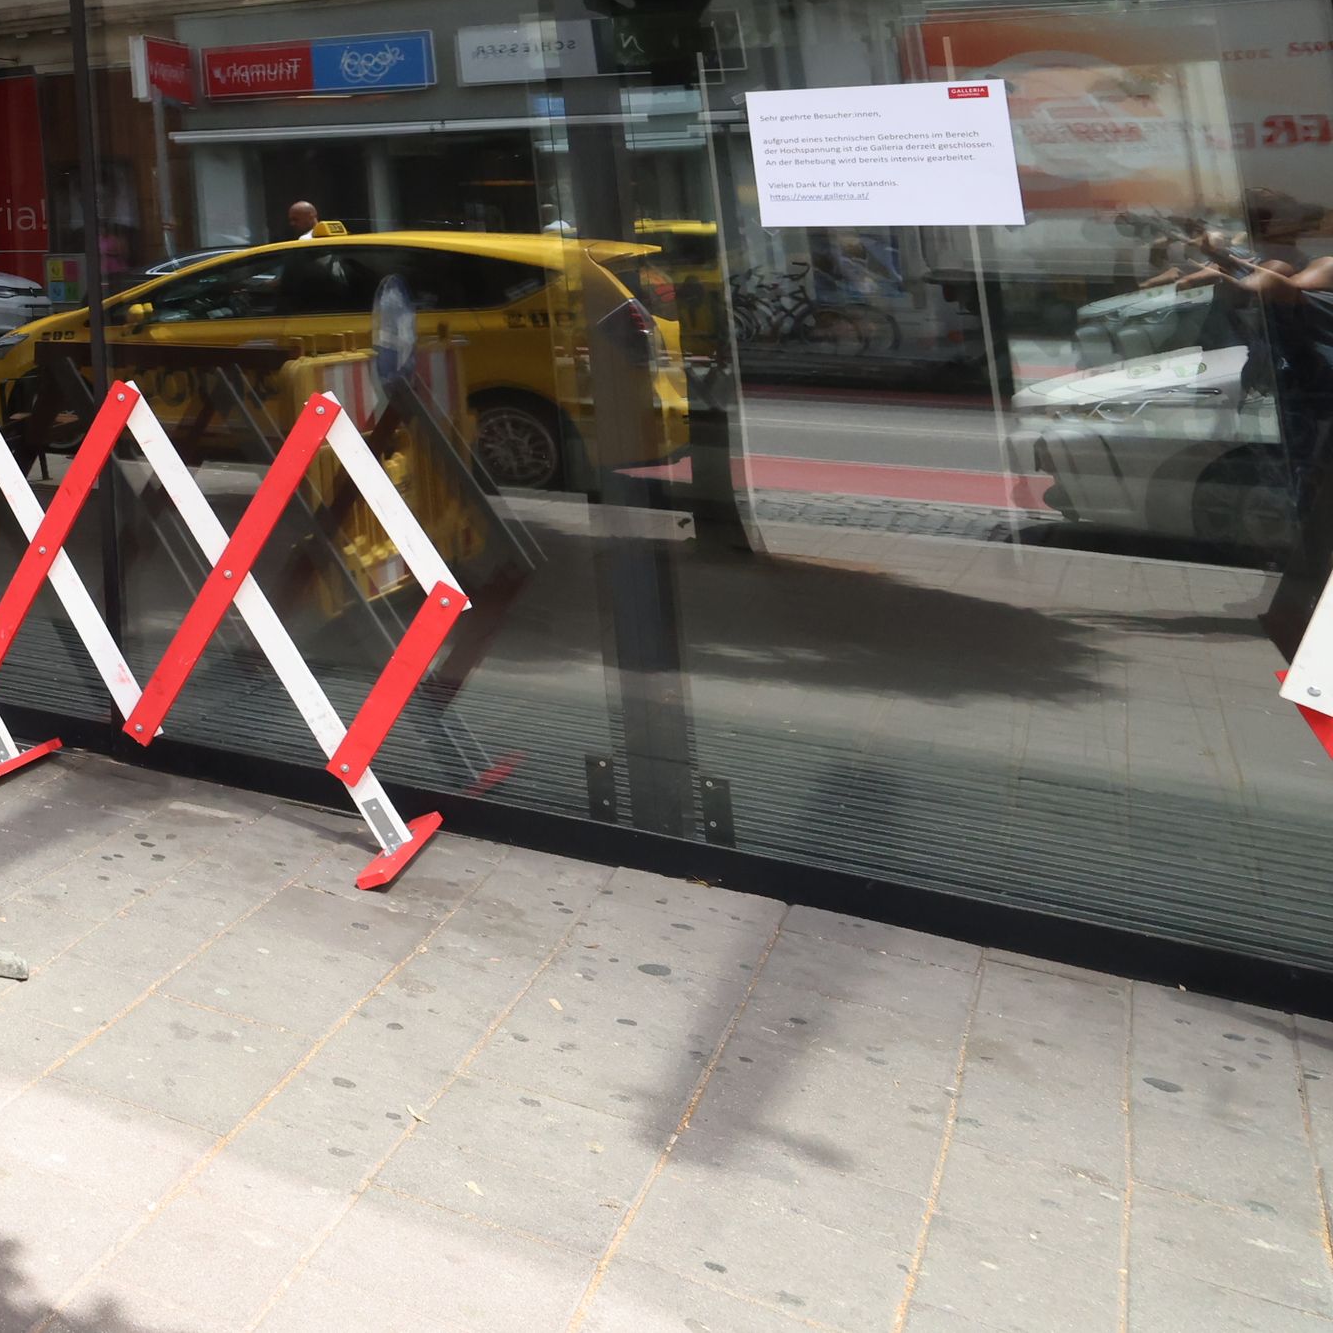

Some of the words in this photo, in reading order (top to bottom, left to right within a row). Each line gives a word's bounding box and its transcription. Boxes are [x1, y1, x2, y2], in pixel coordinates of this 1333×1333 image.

[950, 87, 985, 95] GALLERIA
[780, 114, 812, 123] geehrte
[763, 137, 800, 145] aufgrund
[825, 134, 876, 142] technischen
[878, 132, 930, 140] Gebrechens
[946, 130, 980, 138] Bereich
[764, 147, 778, 155] der
[780, 146, 841, 154] Hochspannung
[855, 144, 869, 152] die
[870, 143, 904, 152] Galleria
[905, 142, 937, 151] derzeit
[938, 141, 995, 150] geschlossen.
[794, 158, 836, 167] Behebung
[859, 156, 889, 164] bereits
[891, 154, 925, 162] intensiv
[927, 153, 976, 163] gearbeitet.
[768, 181, 794, 189] Vielen
[796, 181, 817, 189] Dank
[833, 180, 845, 188] Ihr
[846, 179, 899, 187] Verständnis.
